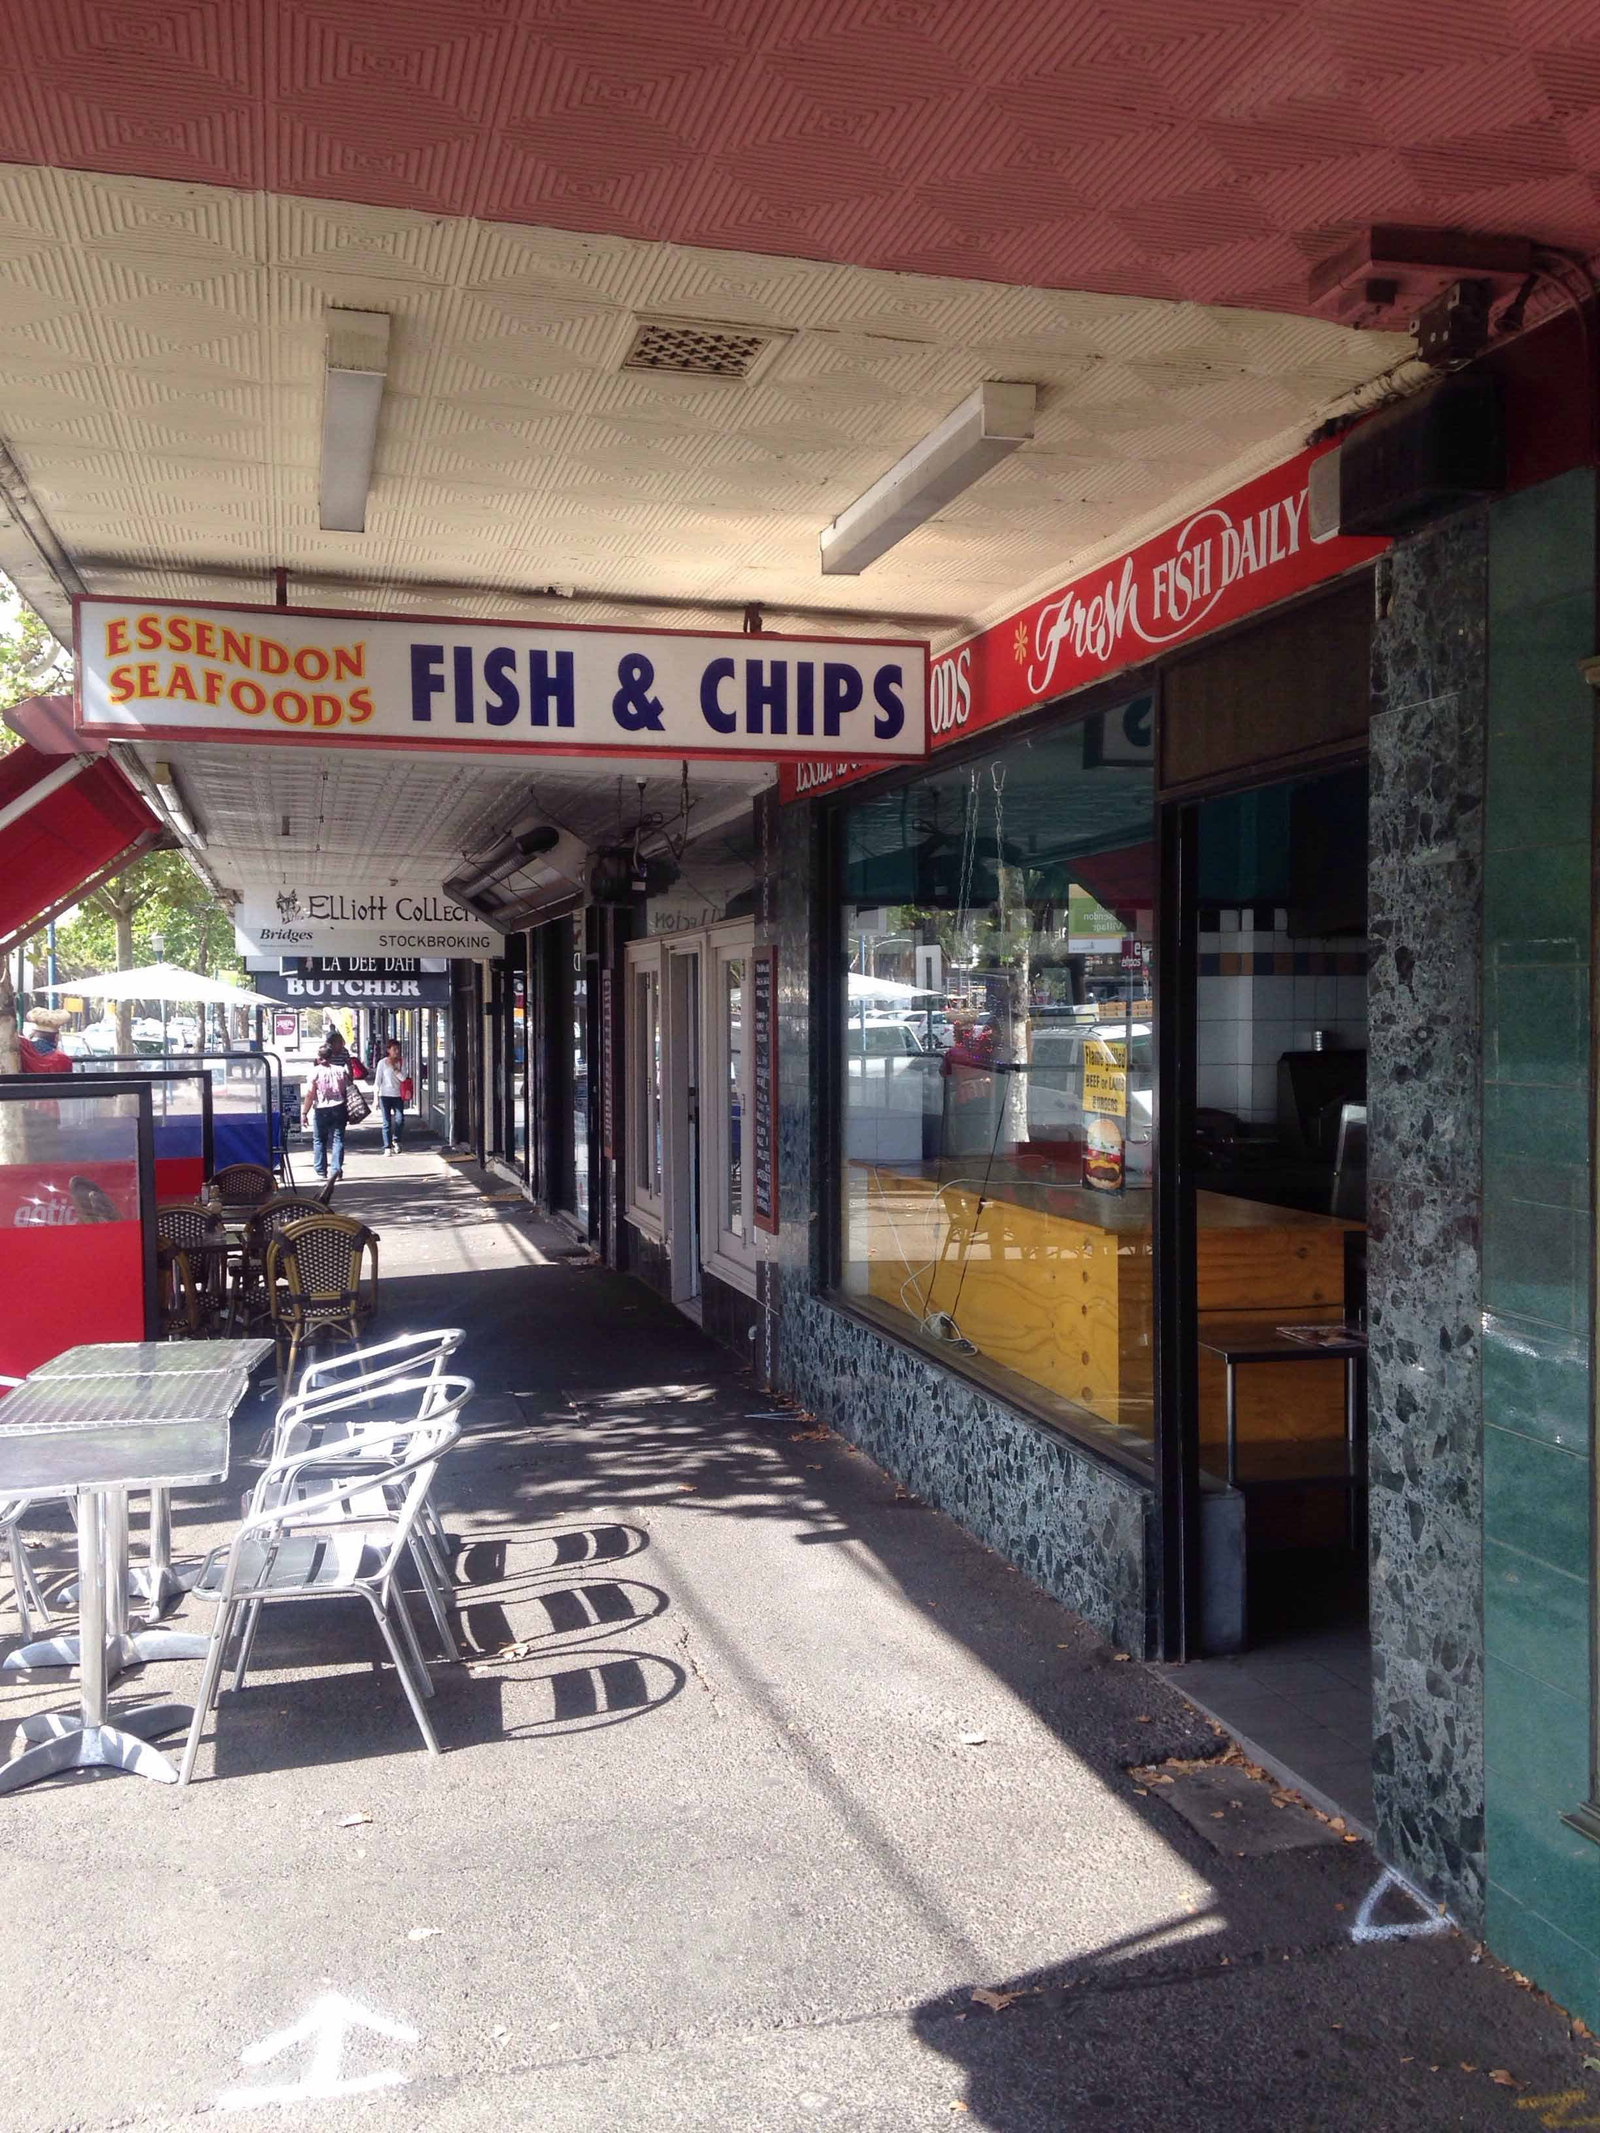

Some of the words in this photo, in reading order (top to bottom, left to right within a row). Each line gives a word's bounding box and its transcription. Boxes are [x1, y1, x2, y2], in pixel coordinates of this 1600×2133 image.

[1028, 556, 1144, 695] Fresh
[1152, 535, 1212, 623] FISH
[1220, 487, 1309, 587] DAILY
[105, 612, 367, 683] ESSENDON
[108, 661, 375, 729] SEAFOODS
[411, 643, 575, 728] FISH
[612, 652, 666, 732] &
[700, 657, 905, 740] CHIPS
[308, 894, 388, 921] Elliott
[260, 928, 314, 944] Bridges
[379, 934, 491, 948] STOCKBROKING
[322, 957, 342, 972] LA
[348, 957, 377, 972] DEE
[384, 957, 416, 972] DAH
[285, 977, 422, 997] BUTCHER
[1086, 1074, 1100, 1088] BEEF
